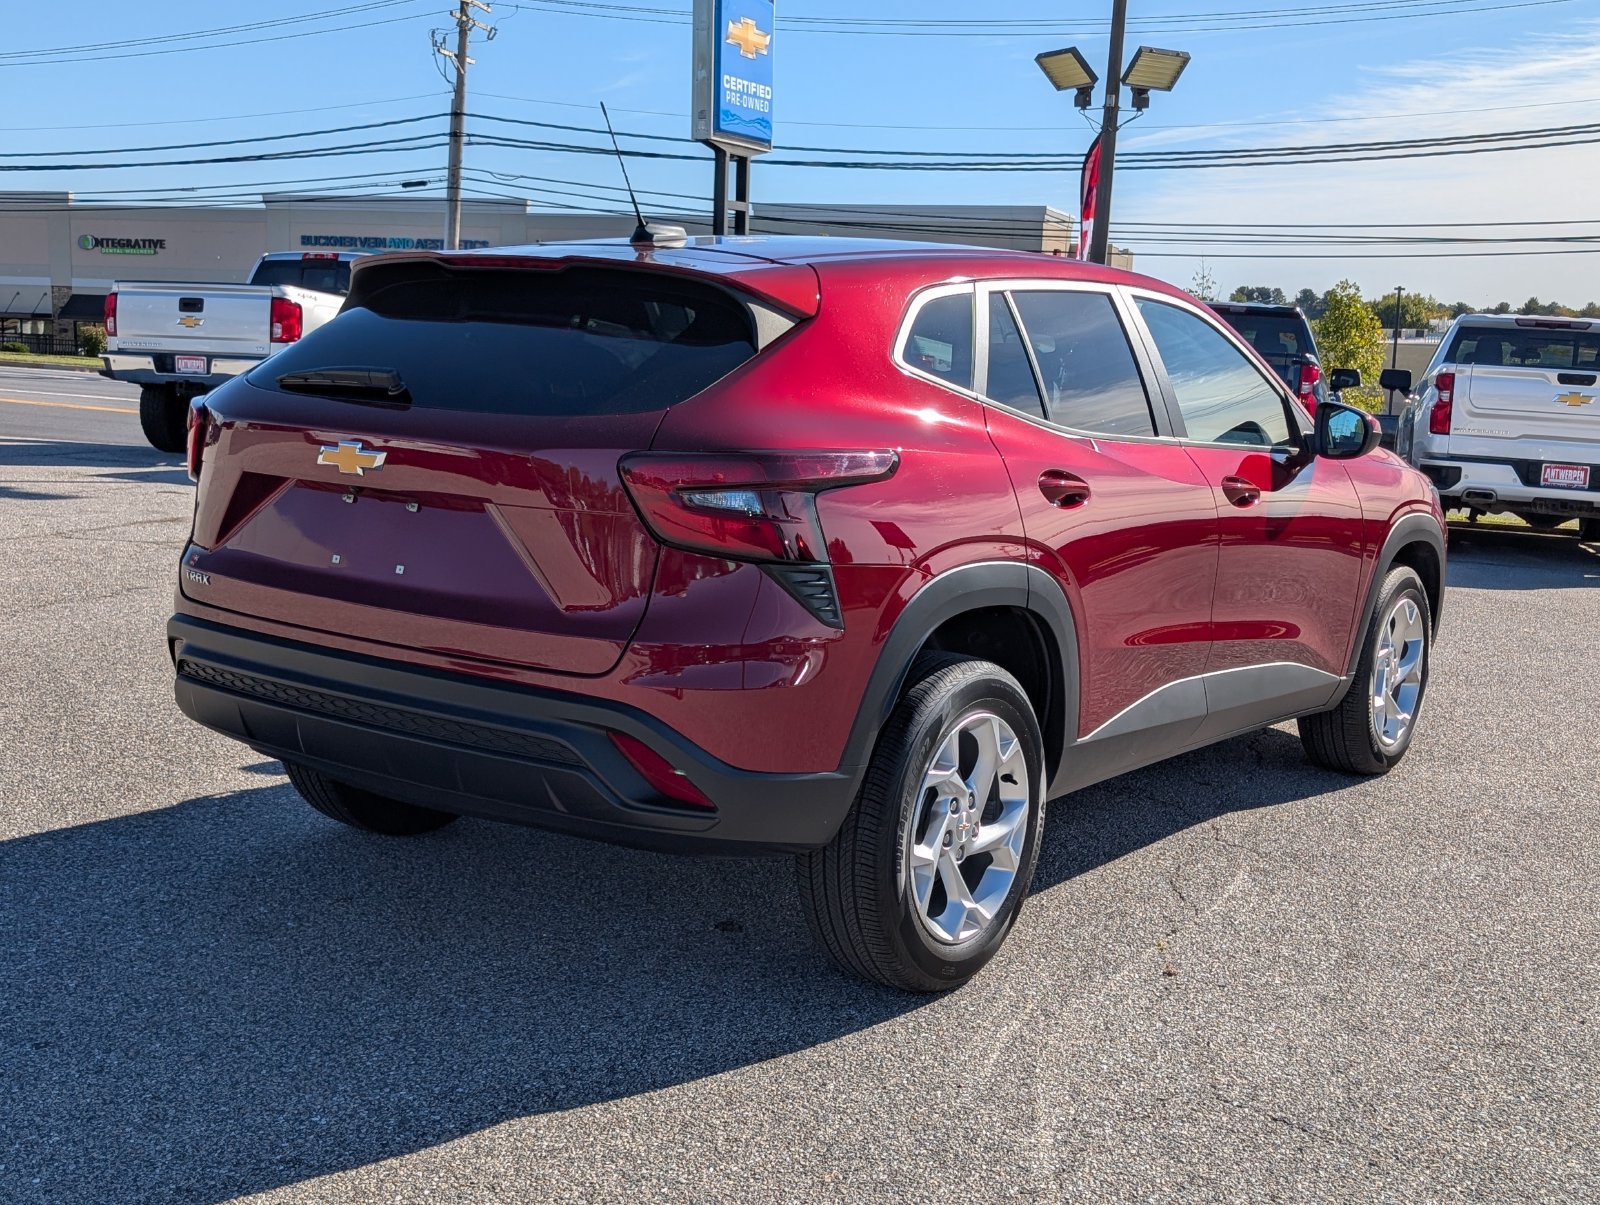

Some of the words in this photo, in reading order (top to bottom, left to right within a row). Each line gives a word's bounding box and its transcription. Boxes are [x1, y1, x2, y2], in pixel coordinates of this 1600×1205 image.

[723, 74, 772, 100] CERTIFIED
[726, 91, 769, 113] PRE-OWNED
[300, 234, 357, 247] BUCKNER
[357, 236, 387, 248] VEIN
[388, 237, 414, 249] AND
[1544, 467, 1585, 482] ANTWERPEN
[186, 569, 210, 586] TRAX
